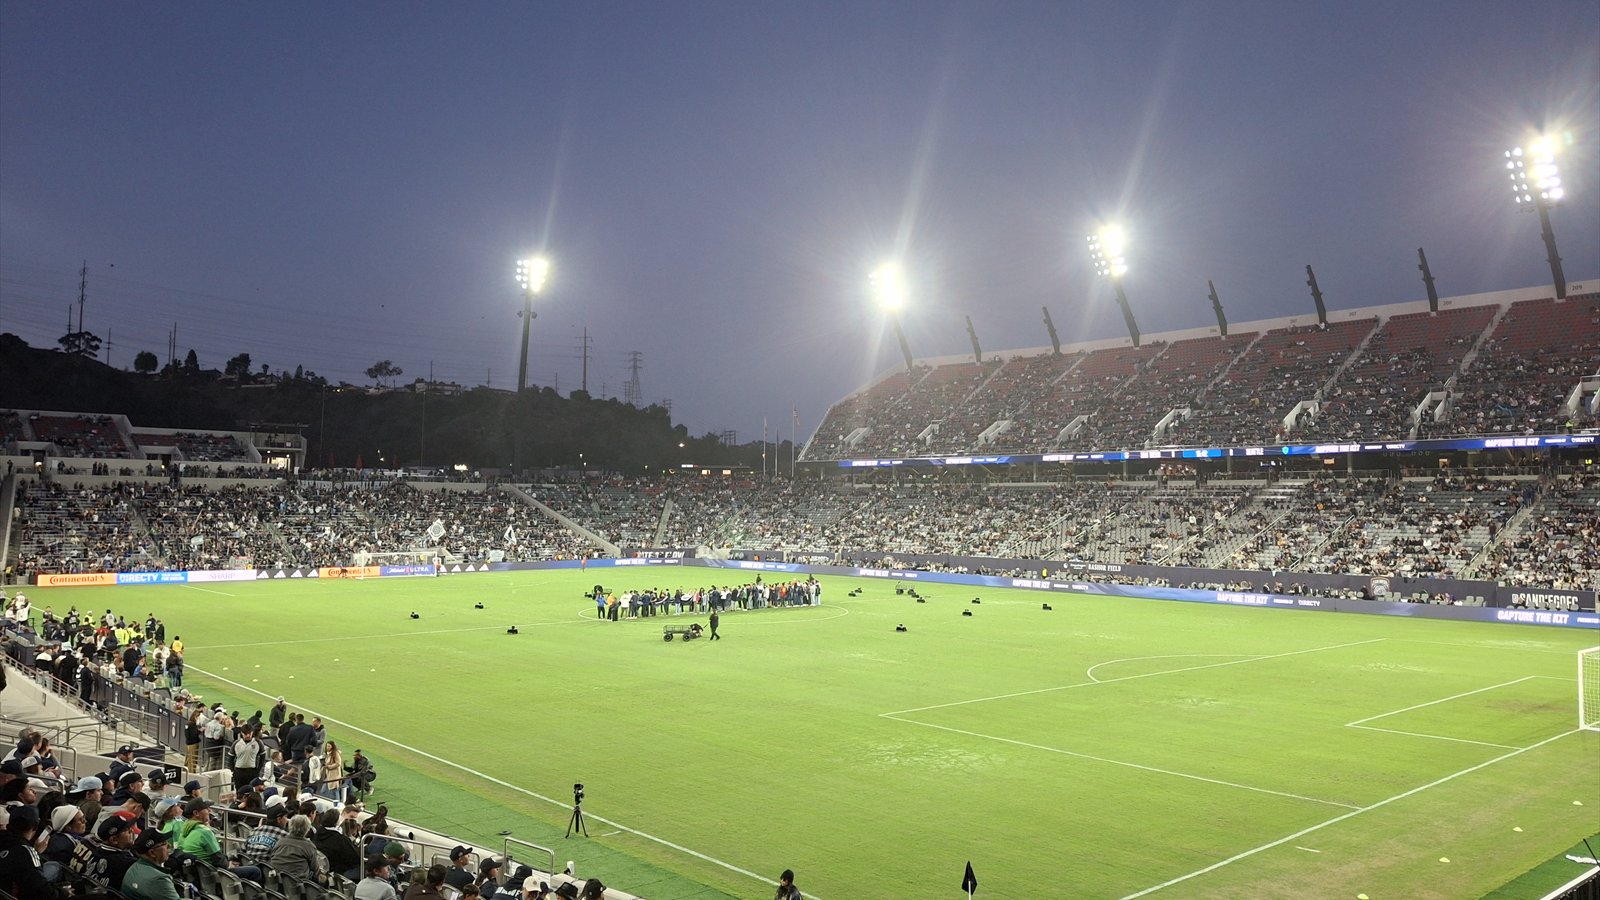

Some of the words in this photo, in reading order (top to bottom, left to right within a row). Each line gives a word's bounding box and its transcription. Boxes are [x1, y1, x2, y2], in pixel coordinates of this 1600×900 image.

[409, 565, 429, 573] ULTRA
[49, 575, 98, 585] Continental
[119, 572, 160, 583] DIRECTV
[1497, 610, 1534, 622] CAPTURE
[1535, 612, 1552, 623] THE
